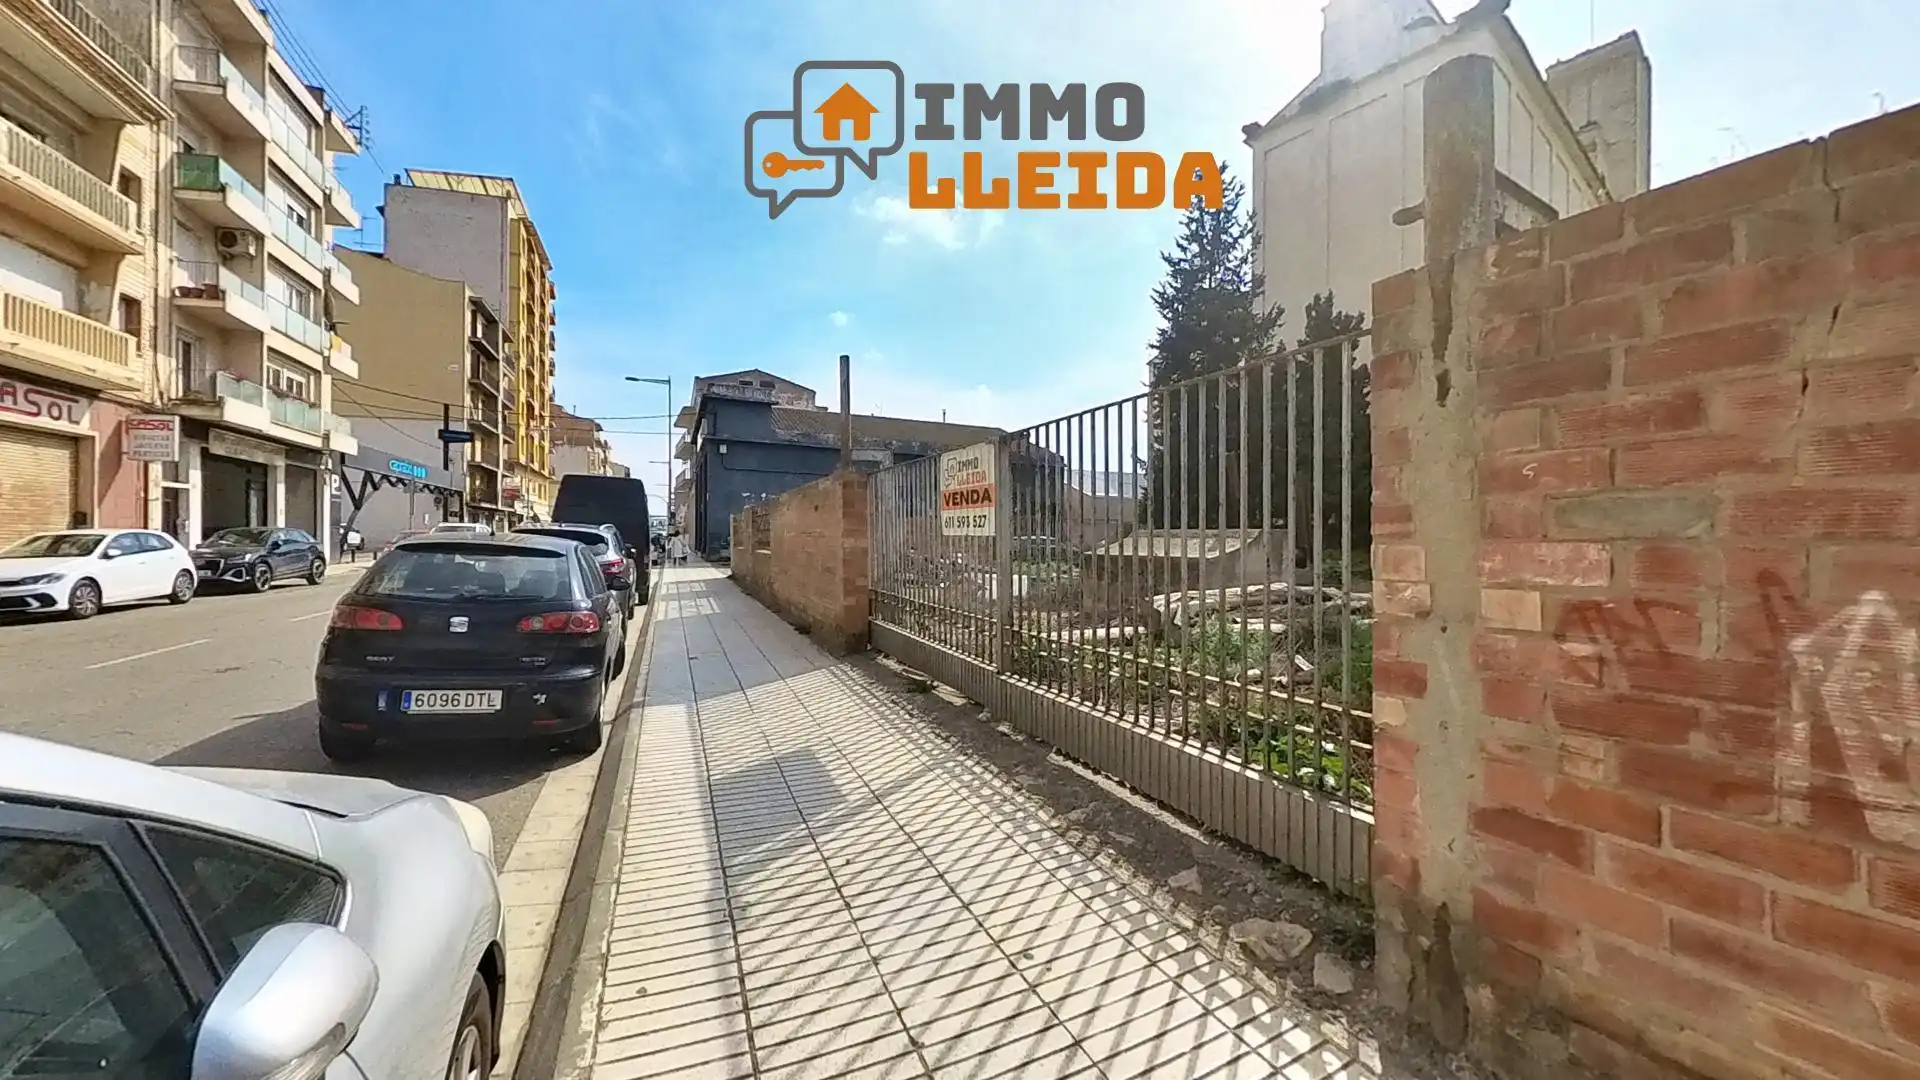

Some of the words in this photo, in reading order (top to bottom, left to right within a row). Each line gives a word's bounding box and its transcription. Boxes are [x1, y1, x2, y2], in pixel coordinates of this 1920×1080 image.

[957, 457, 979, 472] IMMO
[956, 470, 987, 486] LLEIDA
[943, 488, 992, 507] VENDA
[944, 515, 955, 529] 611
[957, 515, 970, 529] 593
[972, 514, 987, 529] 527
[414, 693, 461, 708] 6096
[464, 692, 497, 708] DTL
